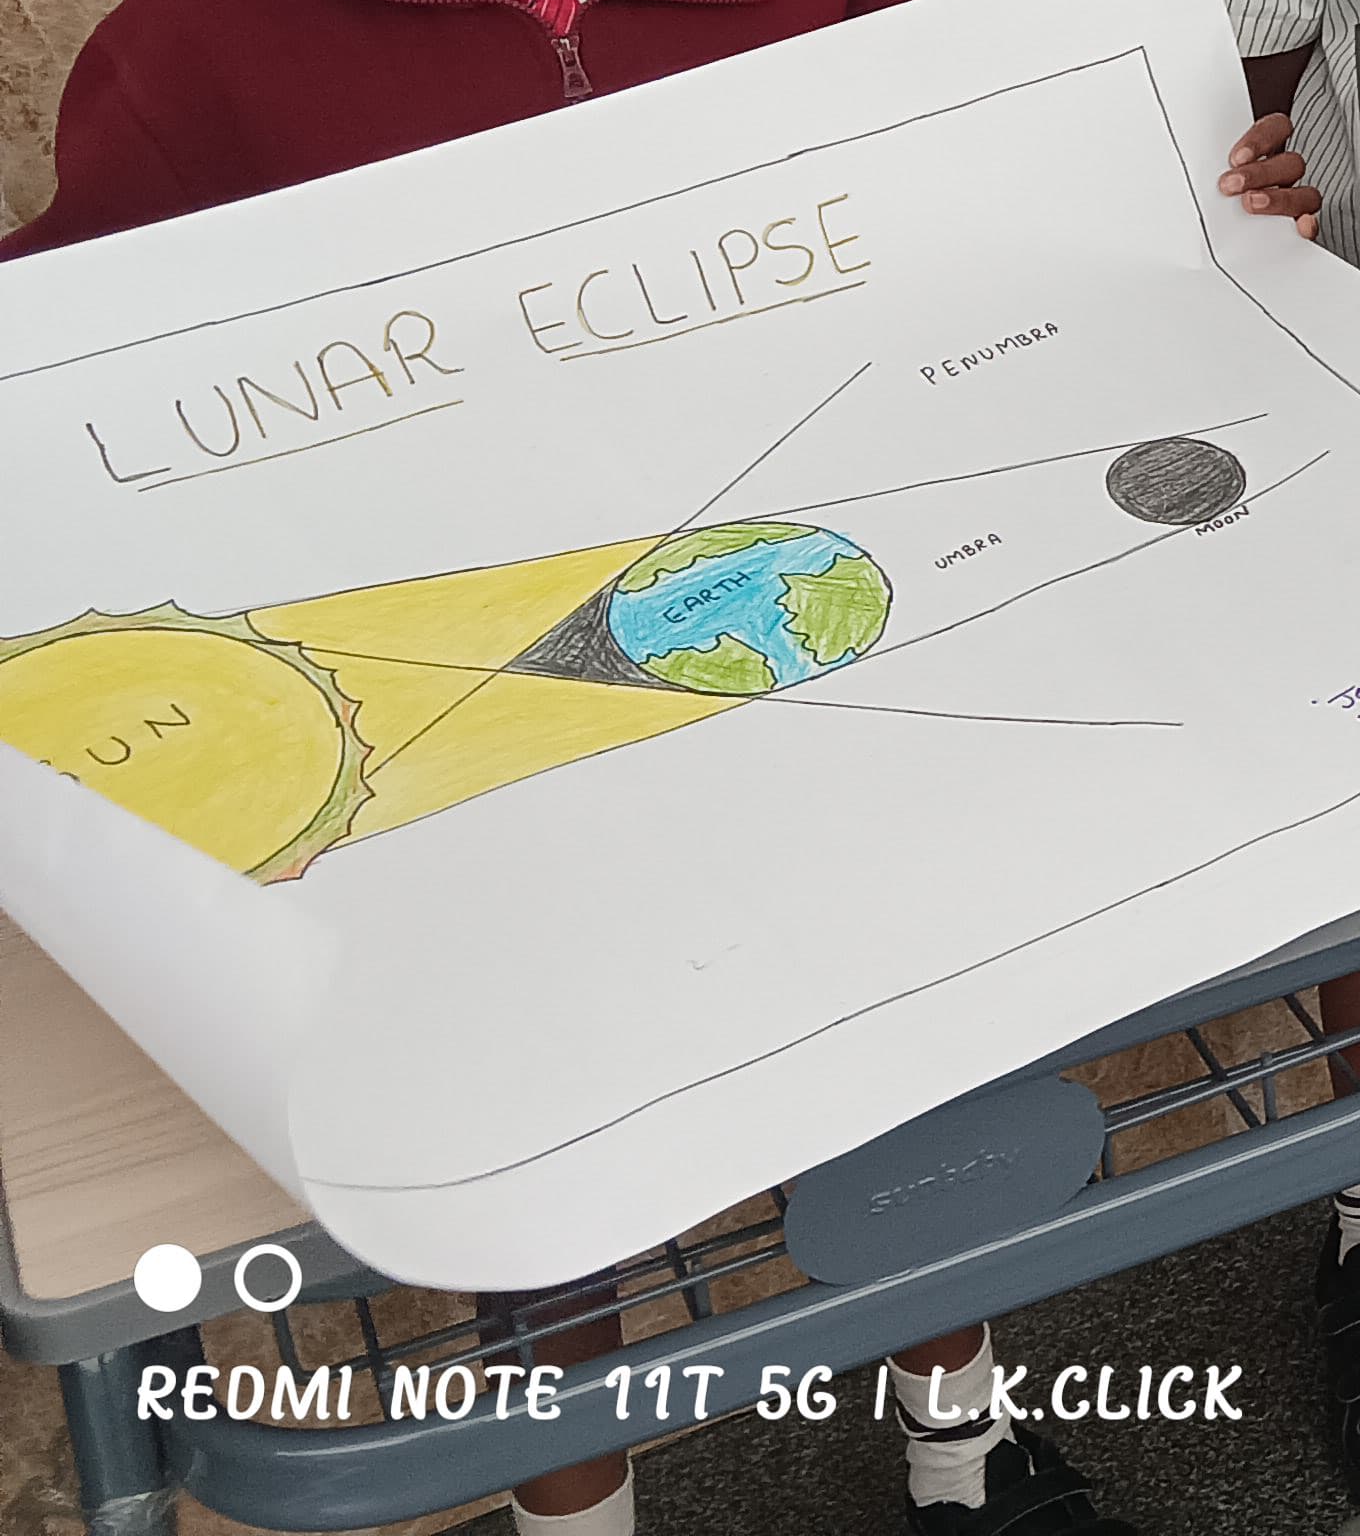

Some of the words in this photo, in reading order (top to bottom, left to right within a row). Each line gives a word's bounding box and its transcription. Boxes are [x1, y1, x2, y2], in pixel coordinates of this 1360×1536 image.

[85, 309, 466, 484] LUNAR
[517, 193, 872, 355] ECLIPSE
[919, 320, 1060, 387] PENUMBRA
[1194, 503, 1251, 538] MOON
[934, 532, 1004, 570] UMBRA
[662, 567, 754, 624] EARTH
